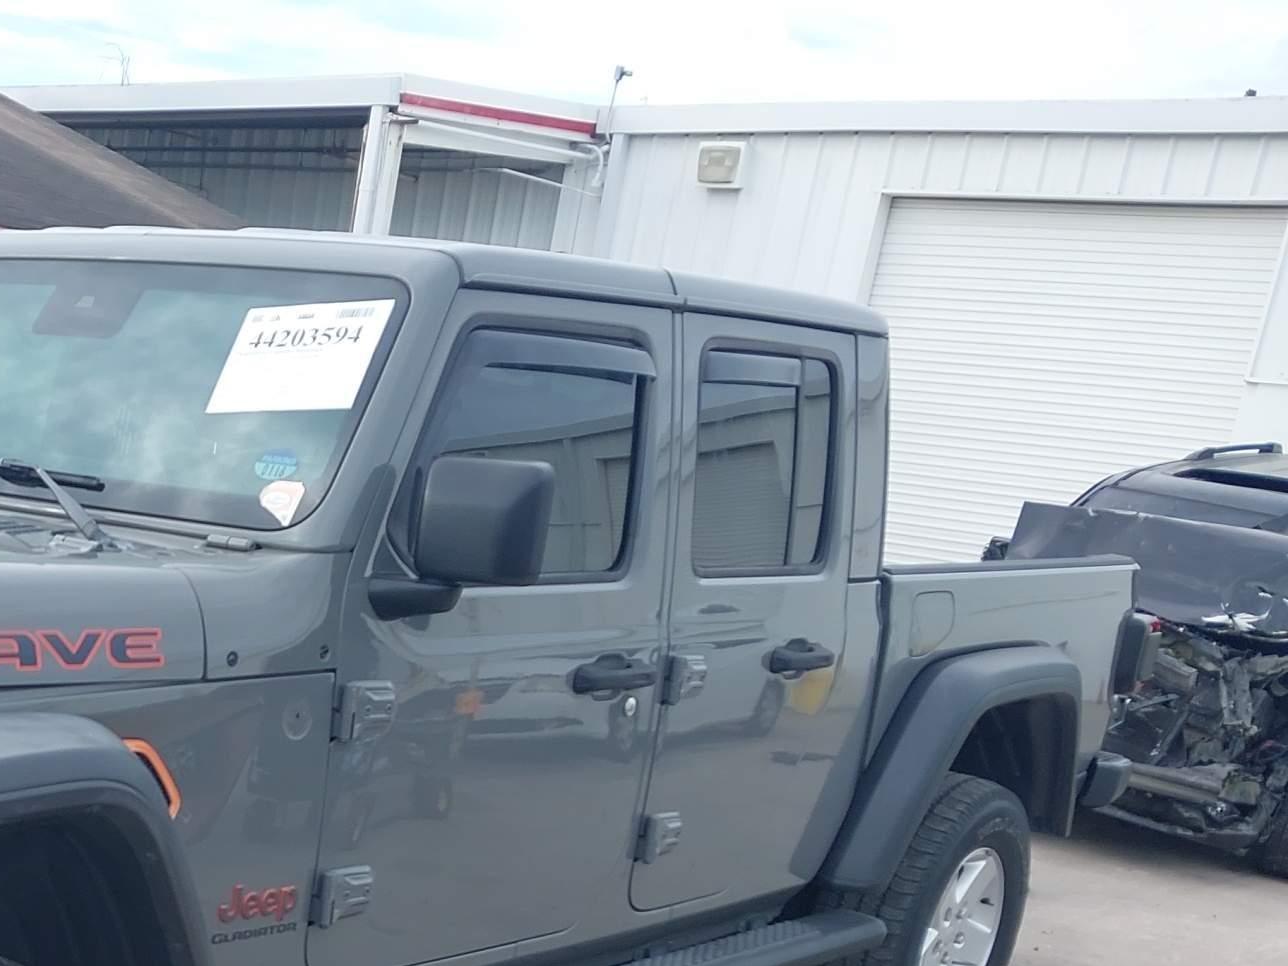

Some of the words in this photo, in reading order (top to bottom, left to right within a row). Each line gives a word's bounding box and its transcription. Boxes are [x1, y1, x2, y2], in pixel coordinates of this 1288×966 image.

[249, 325, 364, 349] 44203594
[216, 882, 297, 923] Jeep
[211, 922, 297, 945] GLADIATOR
